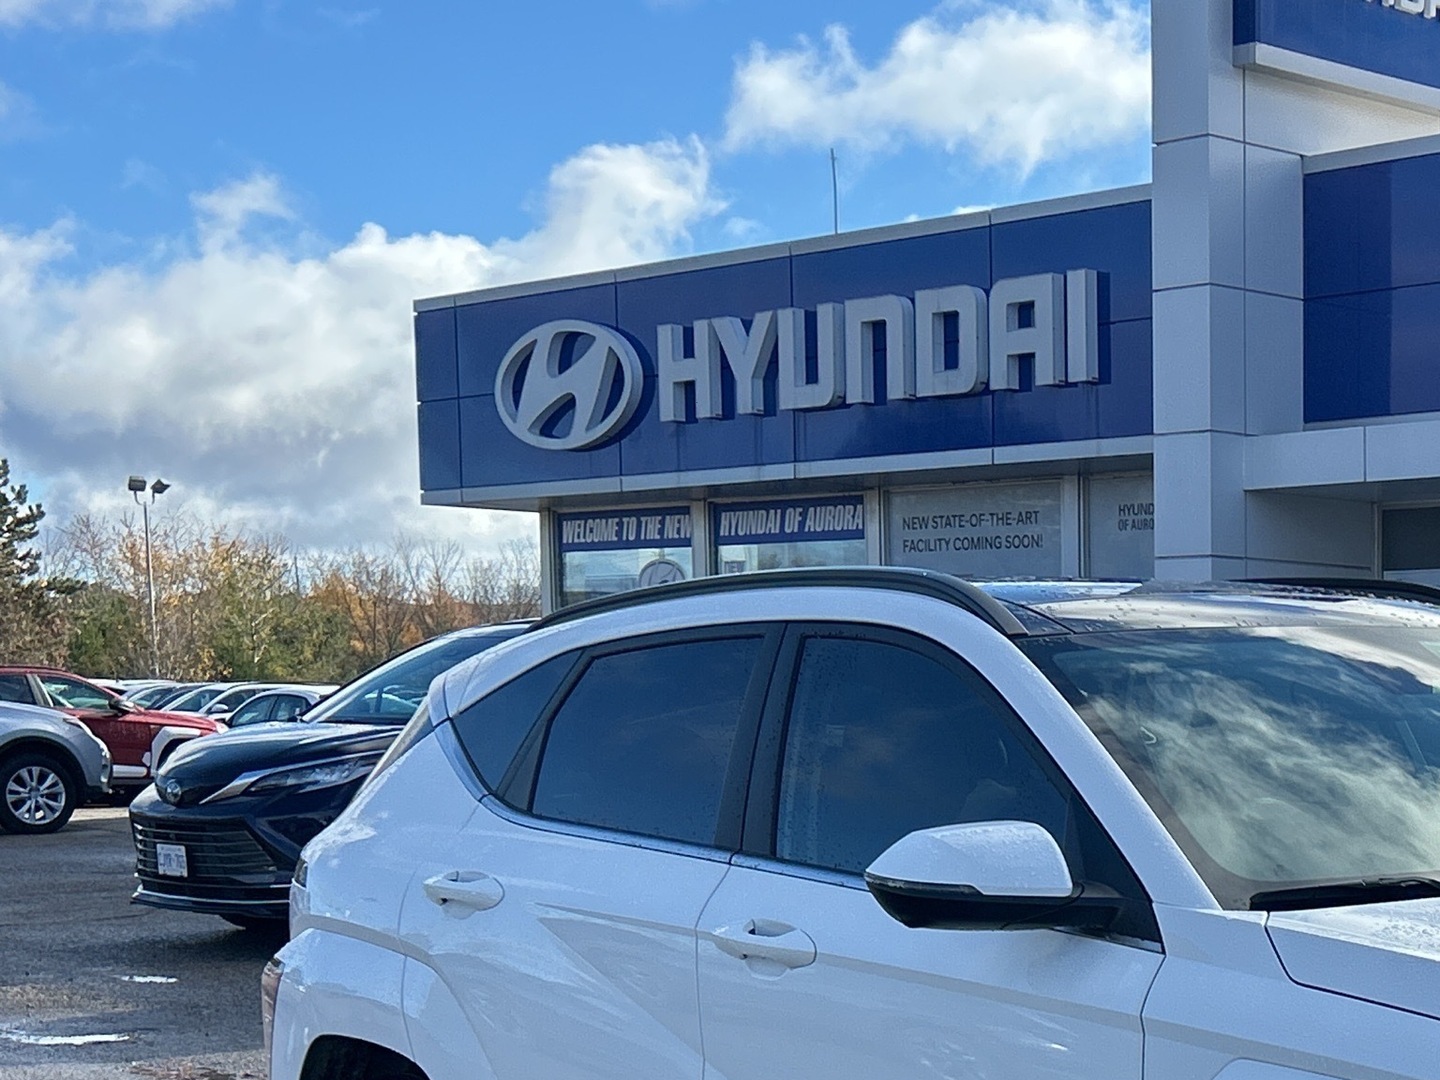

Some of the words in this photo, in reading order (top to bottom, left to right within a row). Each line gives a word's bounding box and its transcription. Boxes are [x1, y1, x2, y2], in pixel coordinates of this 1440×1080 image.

[657, 268, 1099, 422] HYUNDAI
[562, 517, 619, 544] WELCOME
[622, 516, 636, 541] TO
[640, 514, 661, 540] THE
[664, 513, 692, 539] NEW
[719, 509, 781, 537] HYUNDAI
[785, 507, 802, 533] OF
[804, 503, 863, 532] AURORA
[902, 515, 930, 531] NEW
[931, 510, 1040, 530] STATE-OF-THE-ART
[1118, 518, 1129, 532] OF
[902, 536, 951, 553] FACILITY
[953, 535, 1002, 551] COMING
[1004, 533, 1044, 549] SOON!
